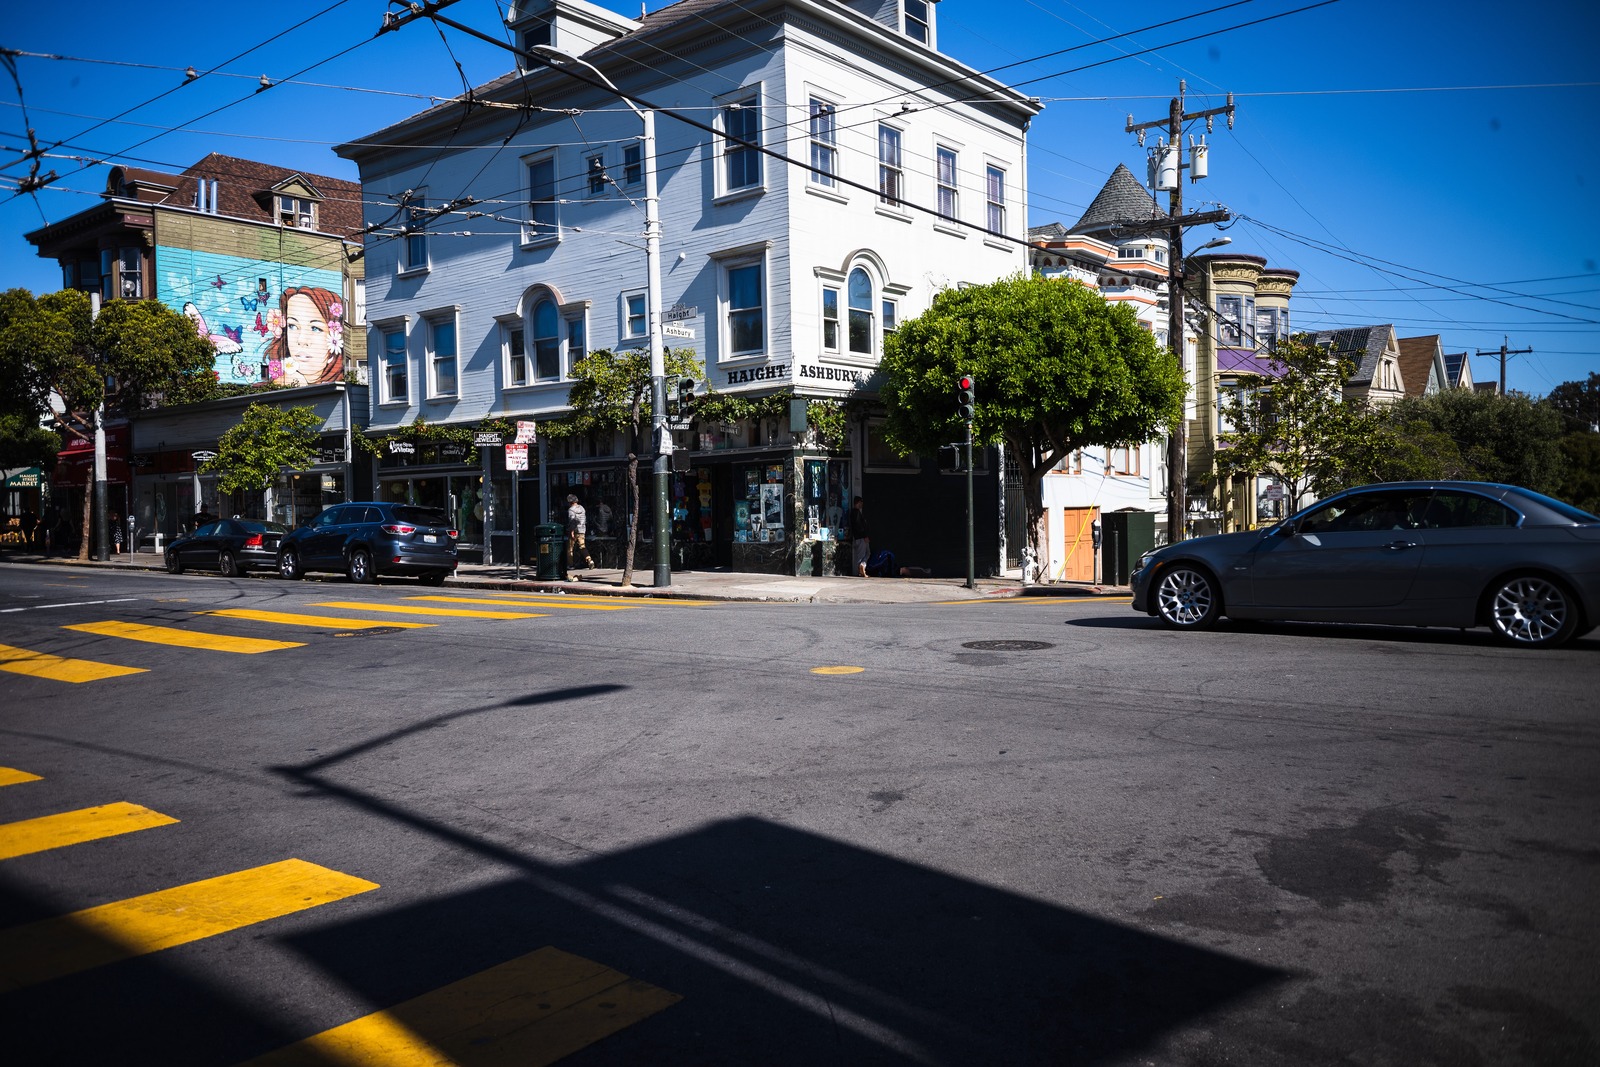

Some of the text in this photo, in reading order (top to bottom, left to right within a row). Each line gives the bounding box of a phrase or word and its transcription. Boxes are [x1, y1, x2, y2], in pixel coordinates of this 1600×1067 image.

[668, 310, 689, 320] Haight
[666, 328, 691, 337] Ashbury
[727, 364, 785, 385] HAIGHT
[799, 364, 859, 382] ASHBURY
